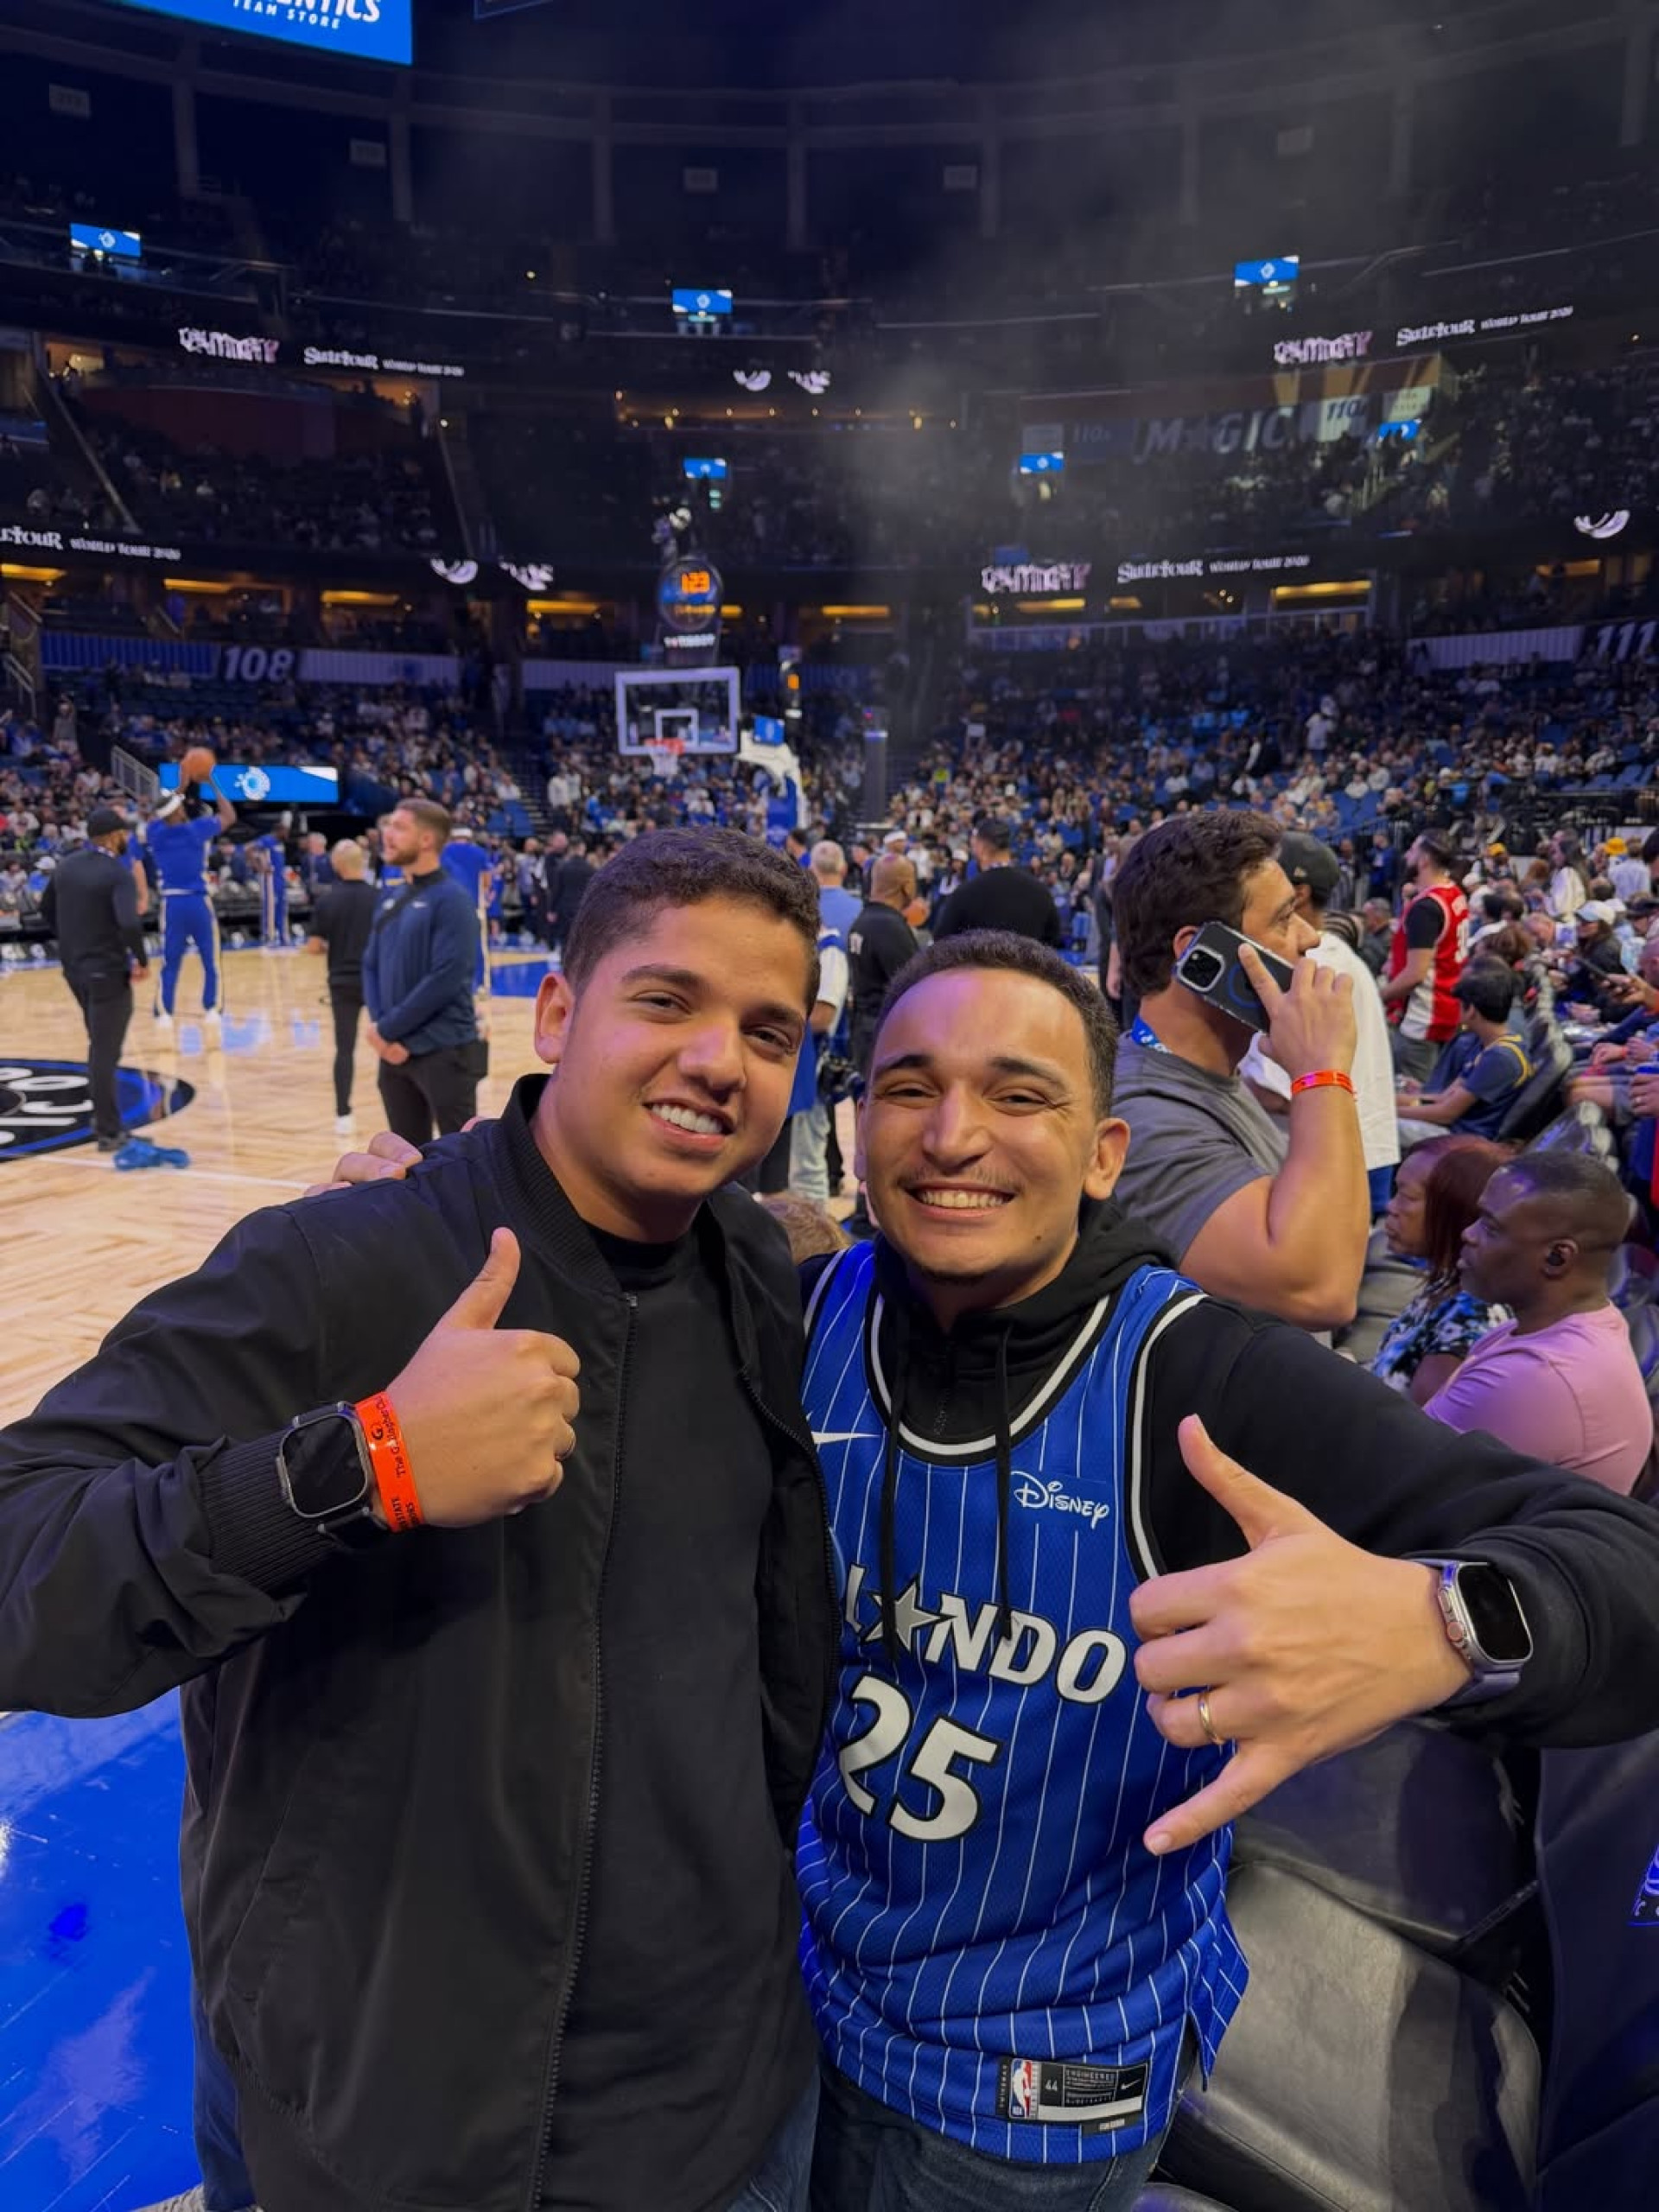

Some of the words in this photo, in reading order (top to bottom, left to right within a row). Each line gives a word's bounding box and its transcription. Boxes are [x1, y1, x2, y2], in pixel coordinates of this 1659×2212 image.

[287, 9, 340, 29] STORE
[1134, 406, 1293, 464] MGIC
[224, 646, 296, 682] 108
[1010, 1471, 1109, 1529] Disney
[837, 1673, 1000, 1841] 25
[1046, 2079, 1058, 2092] 44
